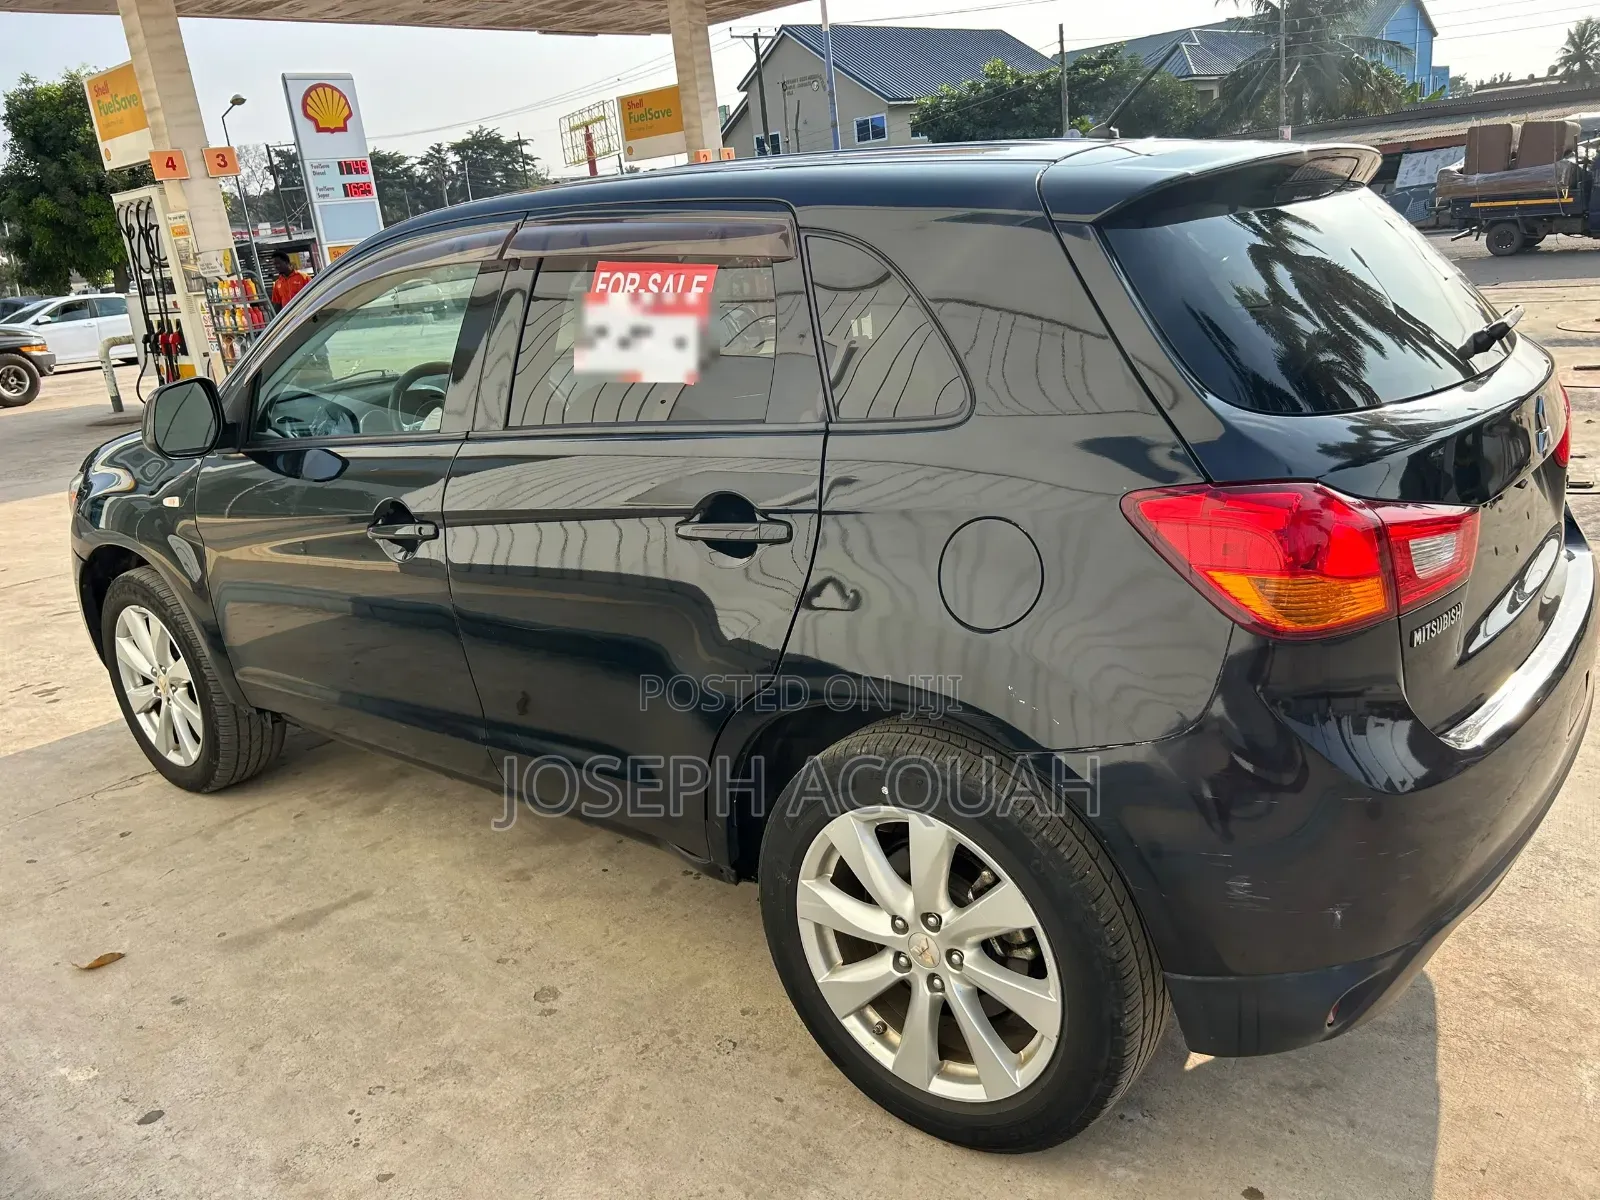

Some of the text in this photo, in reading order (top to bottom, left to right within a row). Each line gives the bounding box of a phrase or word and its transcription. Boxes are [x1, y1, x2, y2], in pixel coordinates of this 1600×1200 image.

[94, 80, 110, 97] Shell
[97, 93, 139, 116] FuelSave
[627, 98, 644, 110] Shell
[628, 107, 672, 125] FuelSave
[165, 156, 177, 171] 4
[215, 153, 228, 168] 3
[1411, 602, 1465, 648] MITSUBISHI
